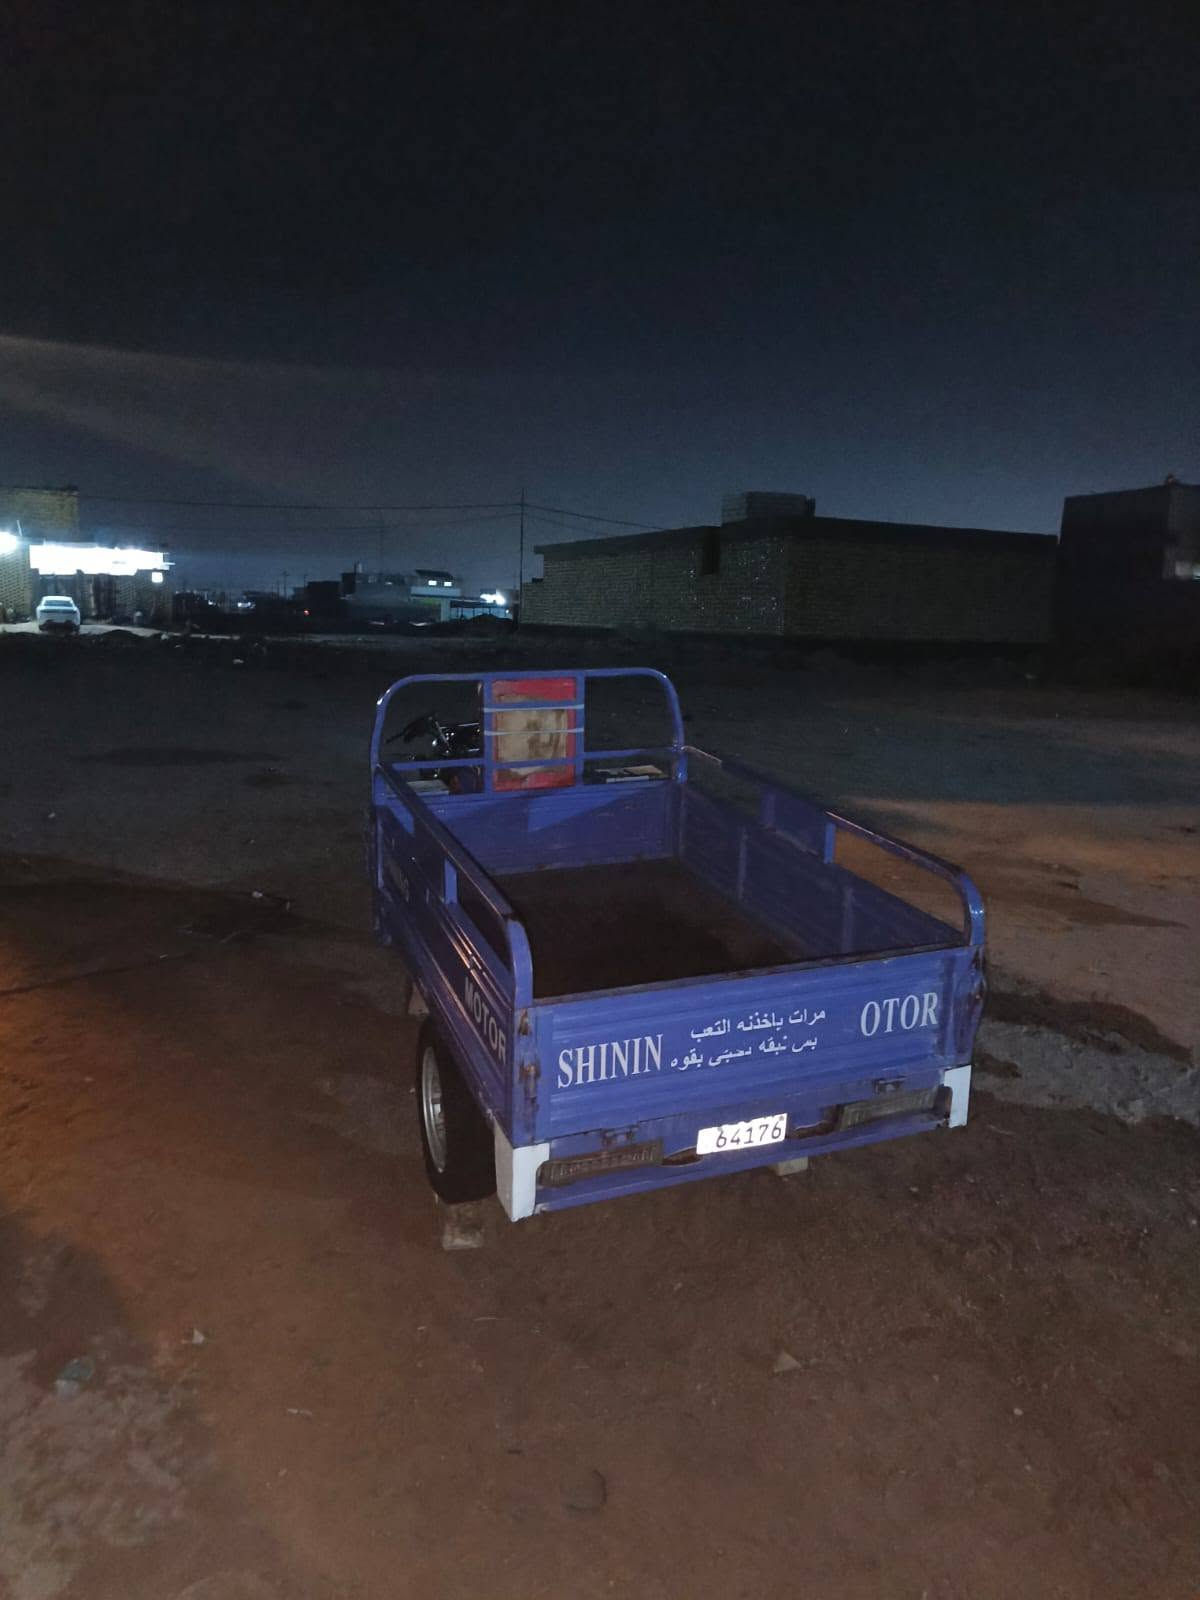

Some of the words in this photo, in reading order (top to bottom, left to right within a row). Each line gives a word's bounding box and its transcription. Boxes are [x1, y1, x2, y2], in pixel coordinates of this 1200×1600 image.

[463, 976, 507, 1065] MOTOR
[689, 1018, 730, 1043] التعب
[788, 1008, 827, 1026] مرات
[860, 992, 938, 1038] OTOR
[556, 1034, 664, 1090] SHININ
[716, 1120, 782, 1148] 64176
